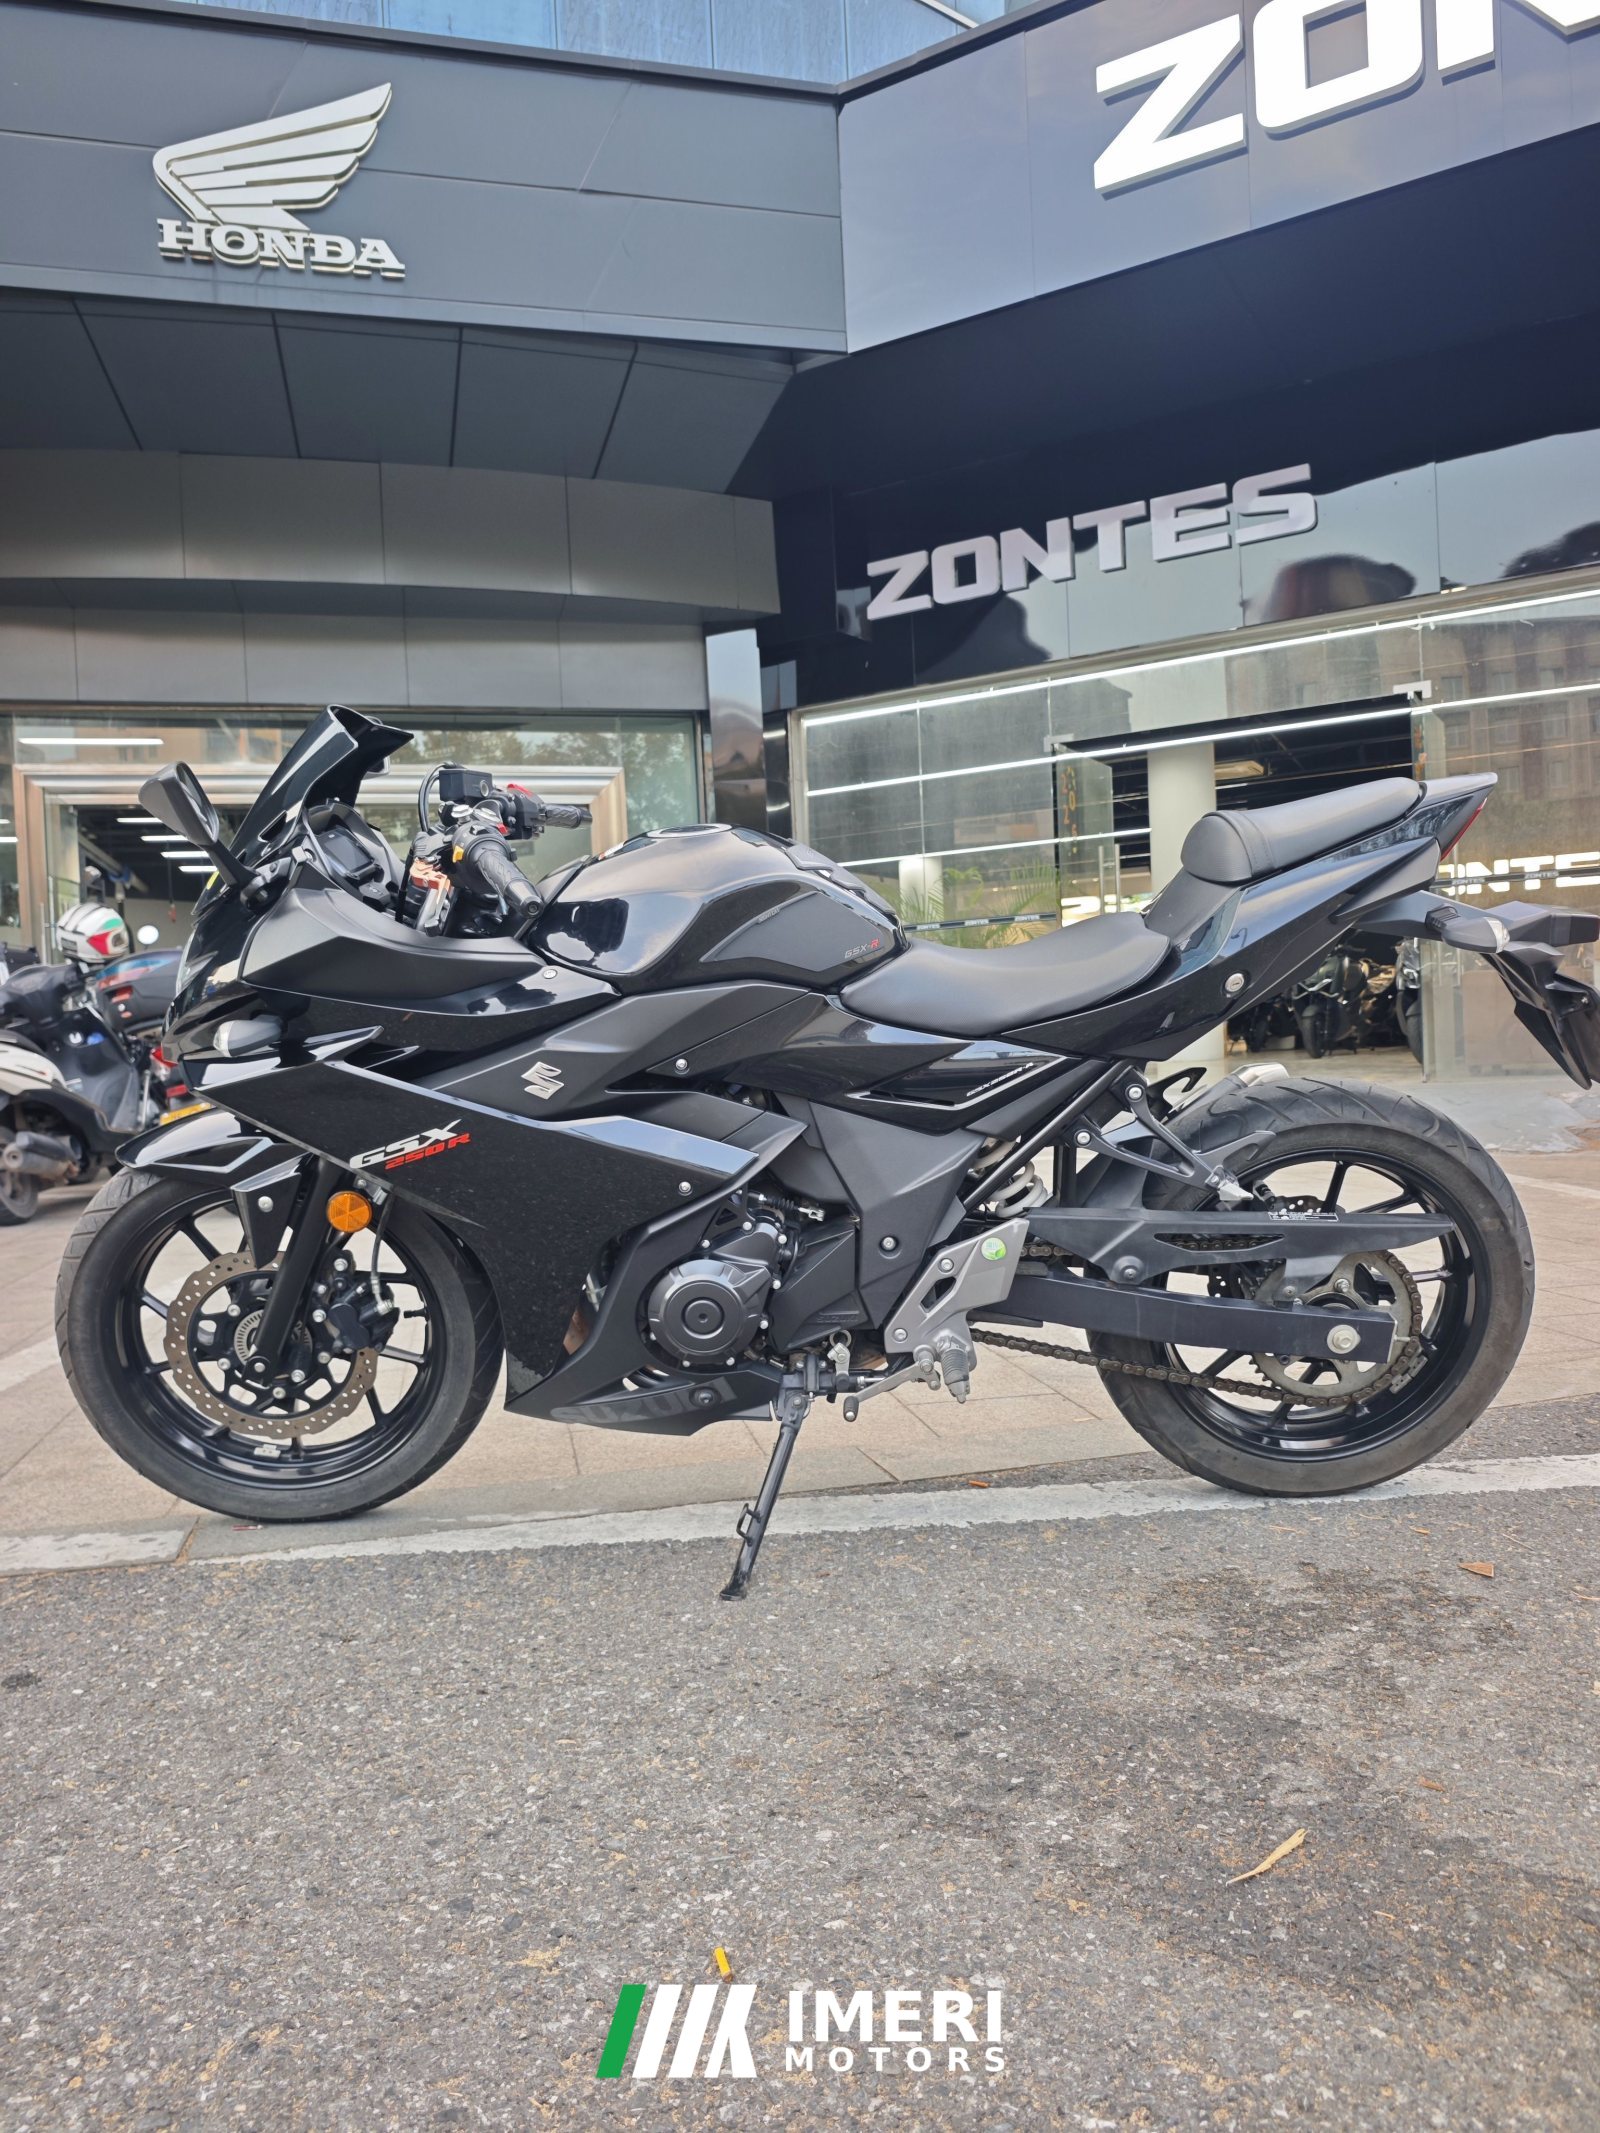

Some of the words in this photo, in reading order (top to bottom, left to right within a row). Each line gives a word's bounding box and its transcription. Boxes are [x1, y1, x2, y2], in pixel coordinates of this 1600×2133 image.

[157, 218, 406, 278] HONDA
[867, 463, 1318, 620] ZONTES
[1524, 871, 1559, 879] ZONTES
[844, 938, 881, 959] GSX-R
[350, 1119, 462, 1169] GSX
